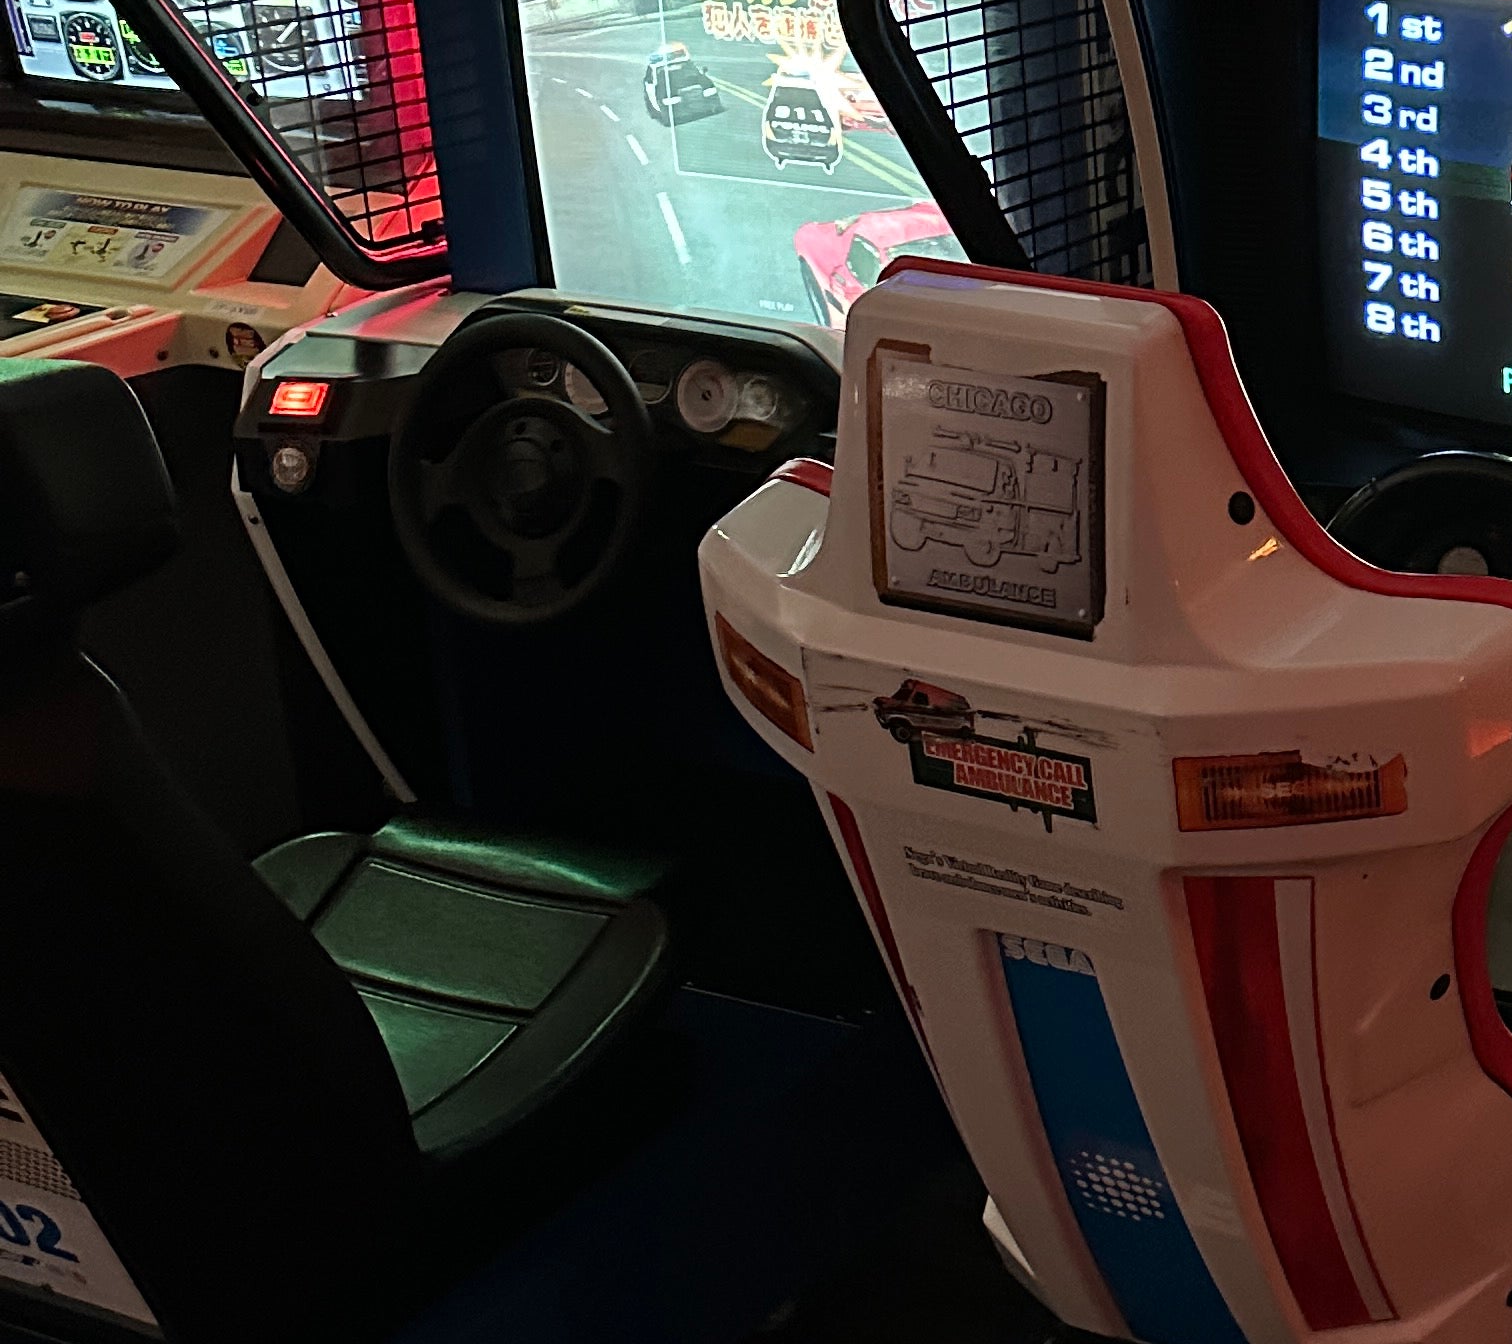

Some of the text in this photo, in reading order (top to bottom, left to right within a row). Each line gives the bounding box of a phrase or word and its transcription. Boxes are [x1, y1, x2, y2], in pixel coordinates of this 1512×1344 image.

[928, 379, 1054, 425] CHICAGO
[926, 569, 1057, 608] AMBULANCE
[924, 733, 1087, 789] EMERGENCY CALL
[955, 762, 1074, 809] AMBULANCE
[1001, 935, 1097, 976] SEGA
